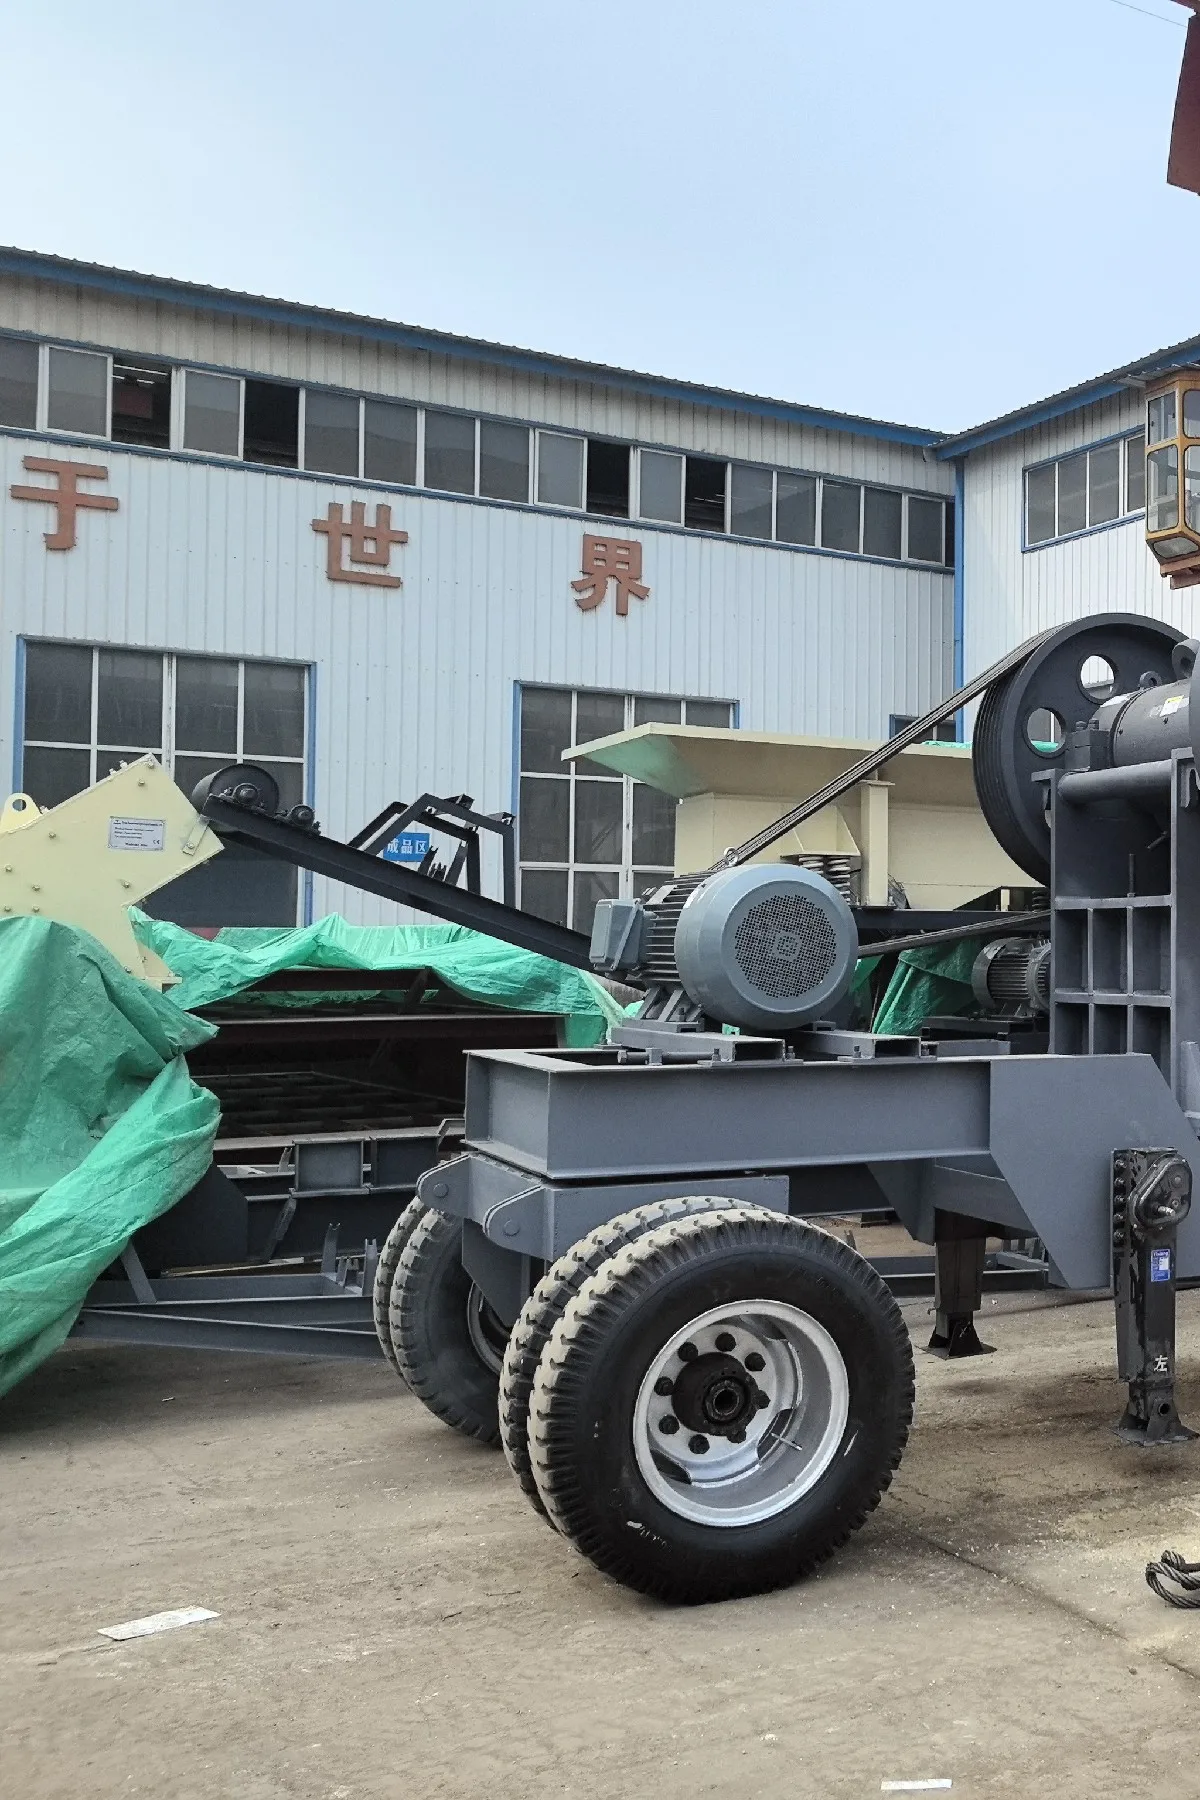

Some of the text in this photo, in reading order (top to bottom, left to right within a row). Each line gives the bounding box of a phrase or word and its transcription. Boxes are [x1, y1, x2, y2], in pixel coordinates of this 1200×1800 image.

[386, 838, 427, 854] 成品区
[1153, 1354, 1168, 1371] 左
